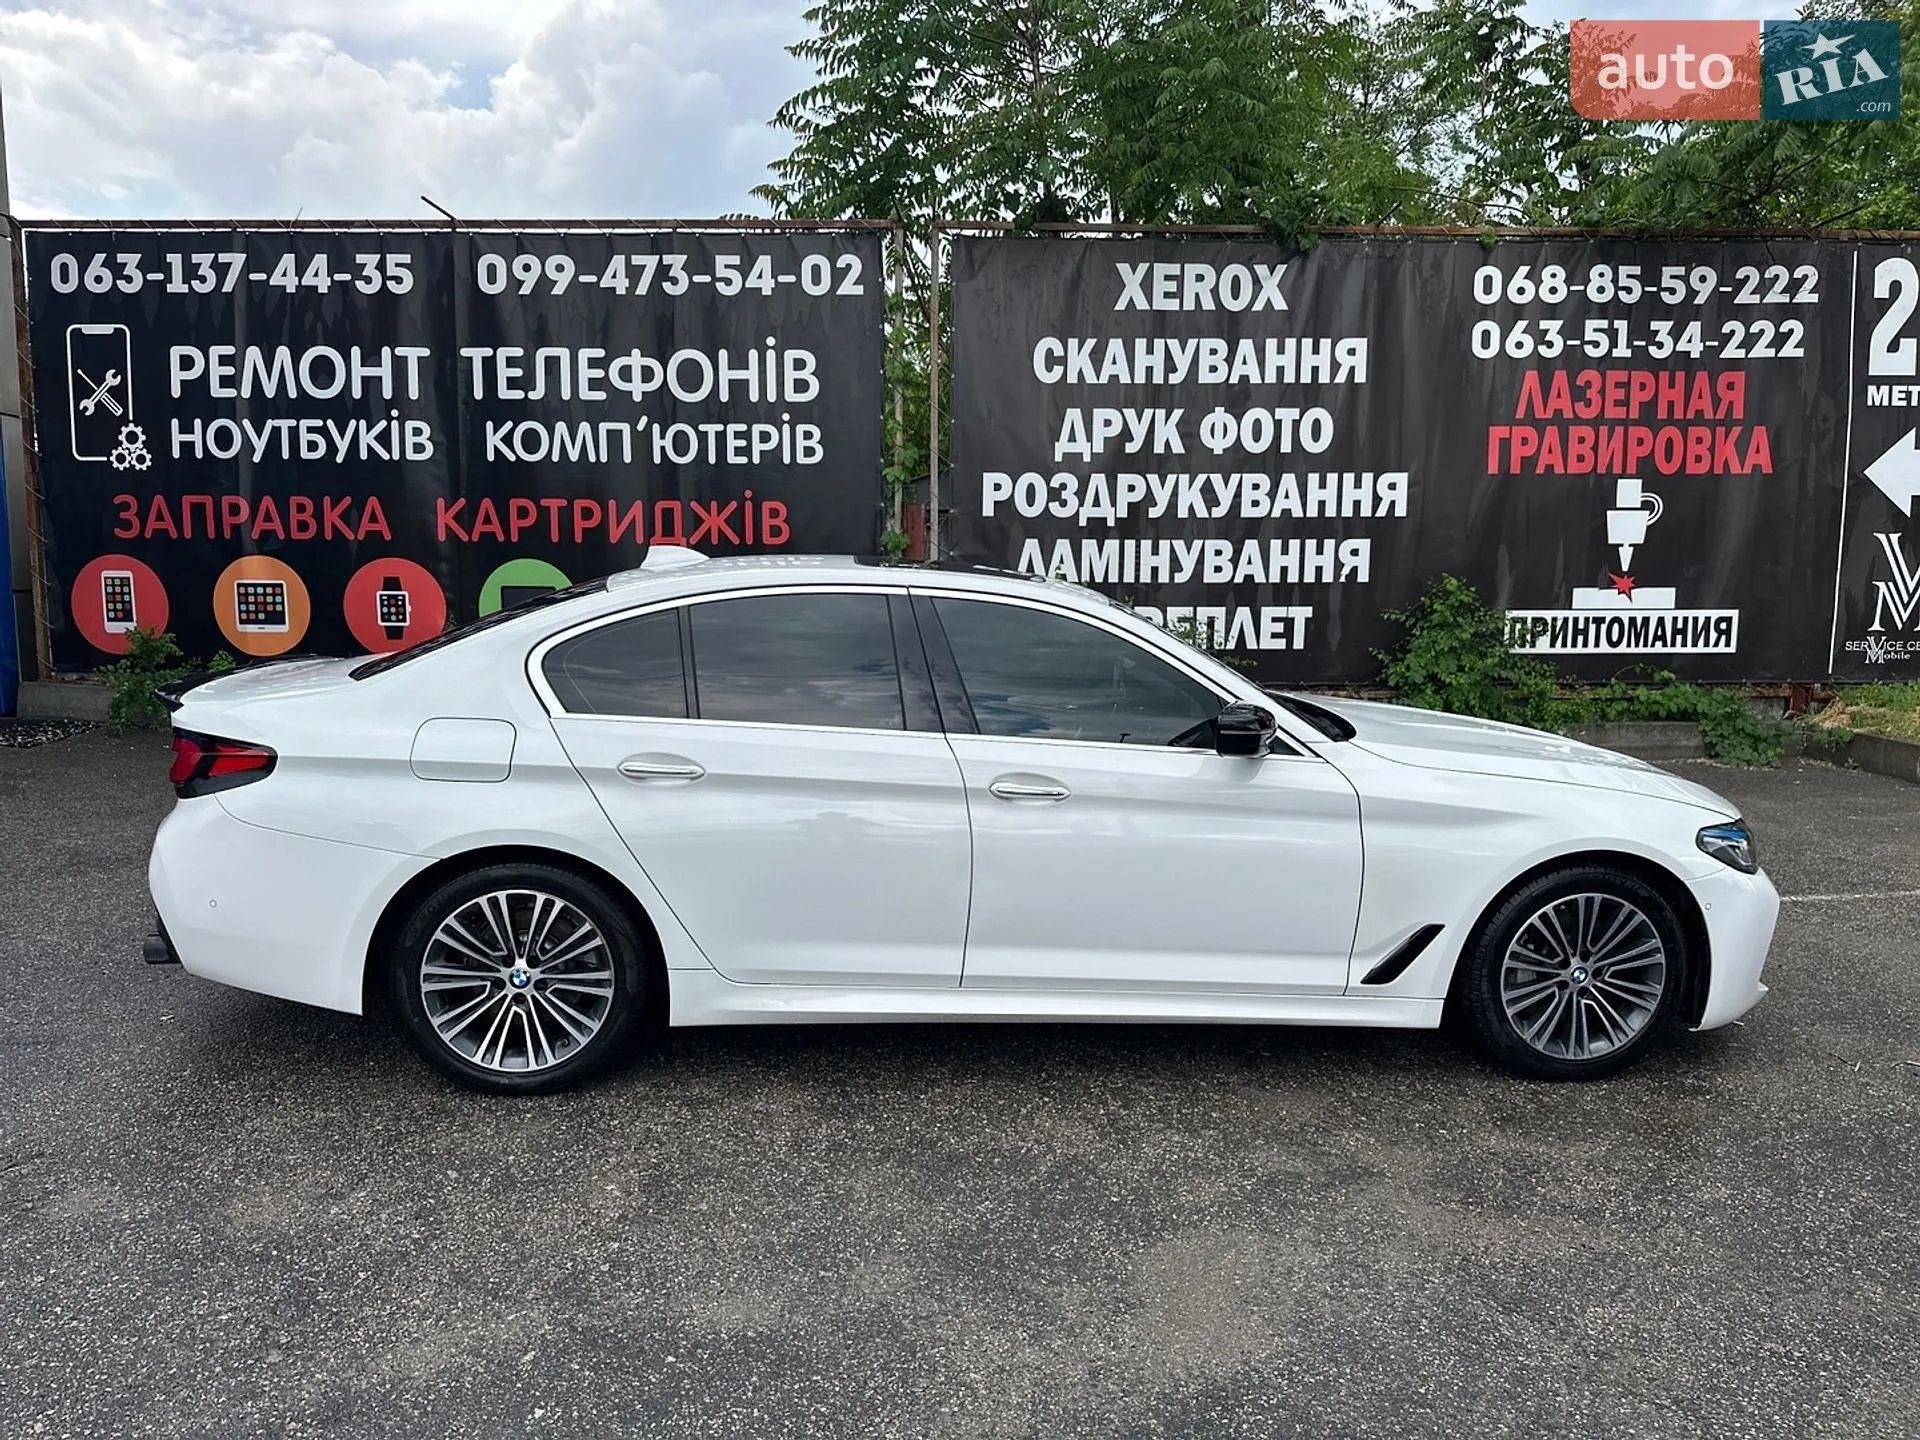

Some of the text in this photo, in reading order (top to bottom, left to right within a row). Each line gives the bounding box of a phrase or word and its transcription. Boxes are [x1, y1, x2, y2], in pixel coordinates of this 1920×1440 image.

[50, 253, 864, 296] 063-137-44-35 099-473-54-02
[1114, 262, 1289, 312] XEROX
[1473, 265, 1820, 305] 068-85-59-222
[1033, 336, 1368, 385] СКАНУВАННЯ
[1471, 320, 1805, 359] 063-51-34-222
[170, 346, 431, 400] РЕМОНТ
[1515, 370, 1746, 420] ЛАЗЕРНАЯ
[1054, 406, 1334, 463] ДРУК ФОТО
[1488, 425, 1773, 475] ГРАВИРОВКА
[113, 495, 392, 541] ЗАПРАВКА
[982, 472, 1409, 527] РОЗДРУКУВАННЯ
[1018, 538, 1371, 584] ЛАМІНУВАННЯ
[1508, 616, 1733, 649] ПРИНТОМАНИЯ
[1845, 636, 1904, 651] SERVICE
[1864, 649, 1912, 664] Mobile
